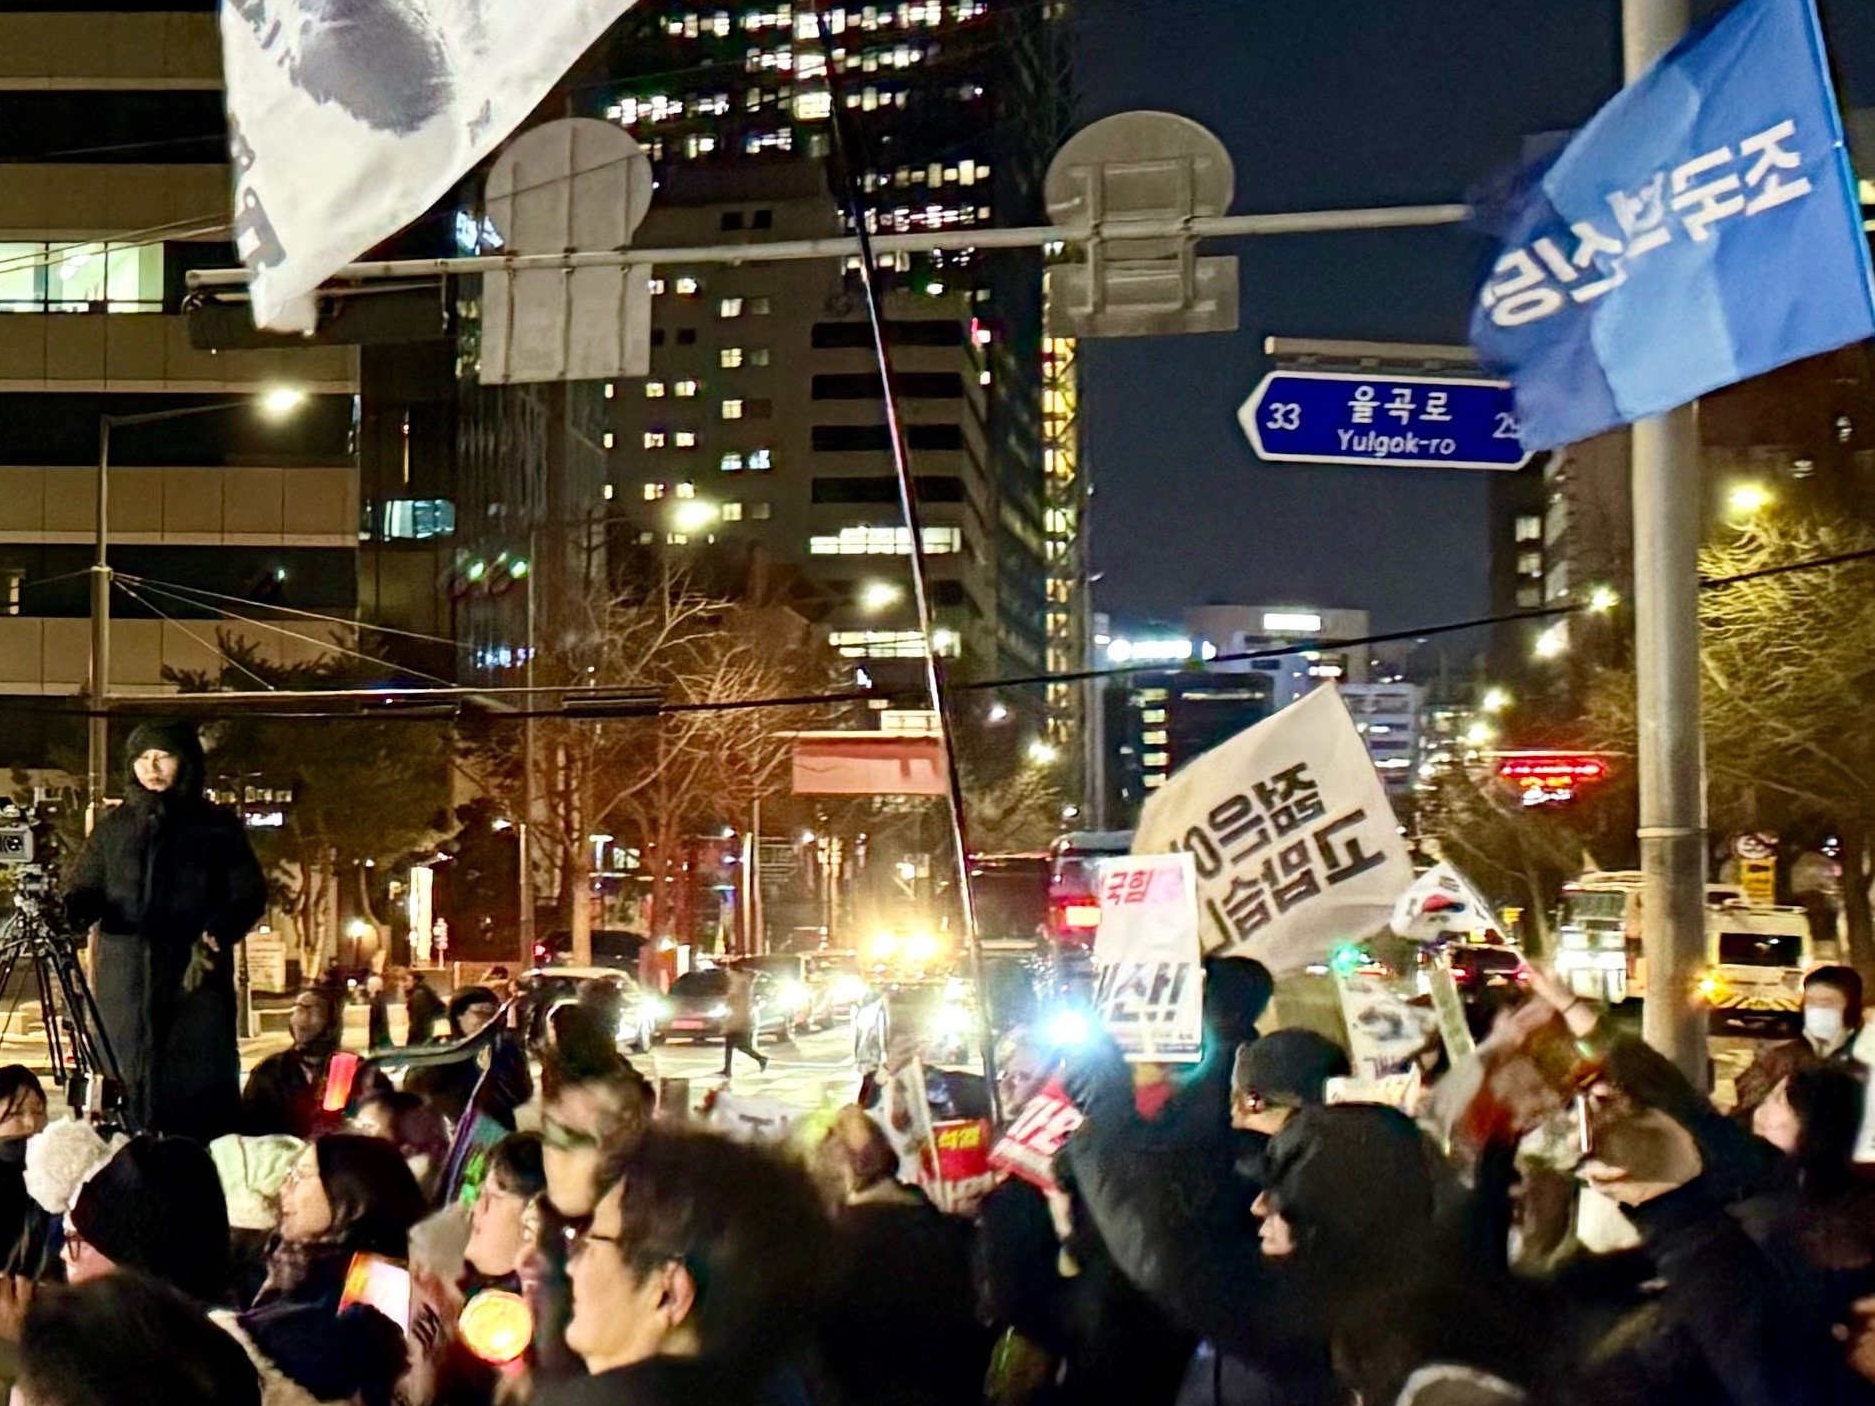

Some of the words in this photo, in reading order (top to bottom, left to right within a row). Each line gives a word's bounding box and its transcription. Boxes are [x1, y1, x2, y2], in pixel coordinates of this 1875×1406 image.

[1266, 402, 1302, 431] 33
[1348, 385, 1452, 425] 율곡로
[1336, 428, 1457, 458] Yulgok-ro
